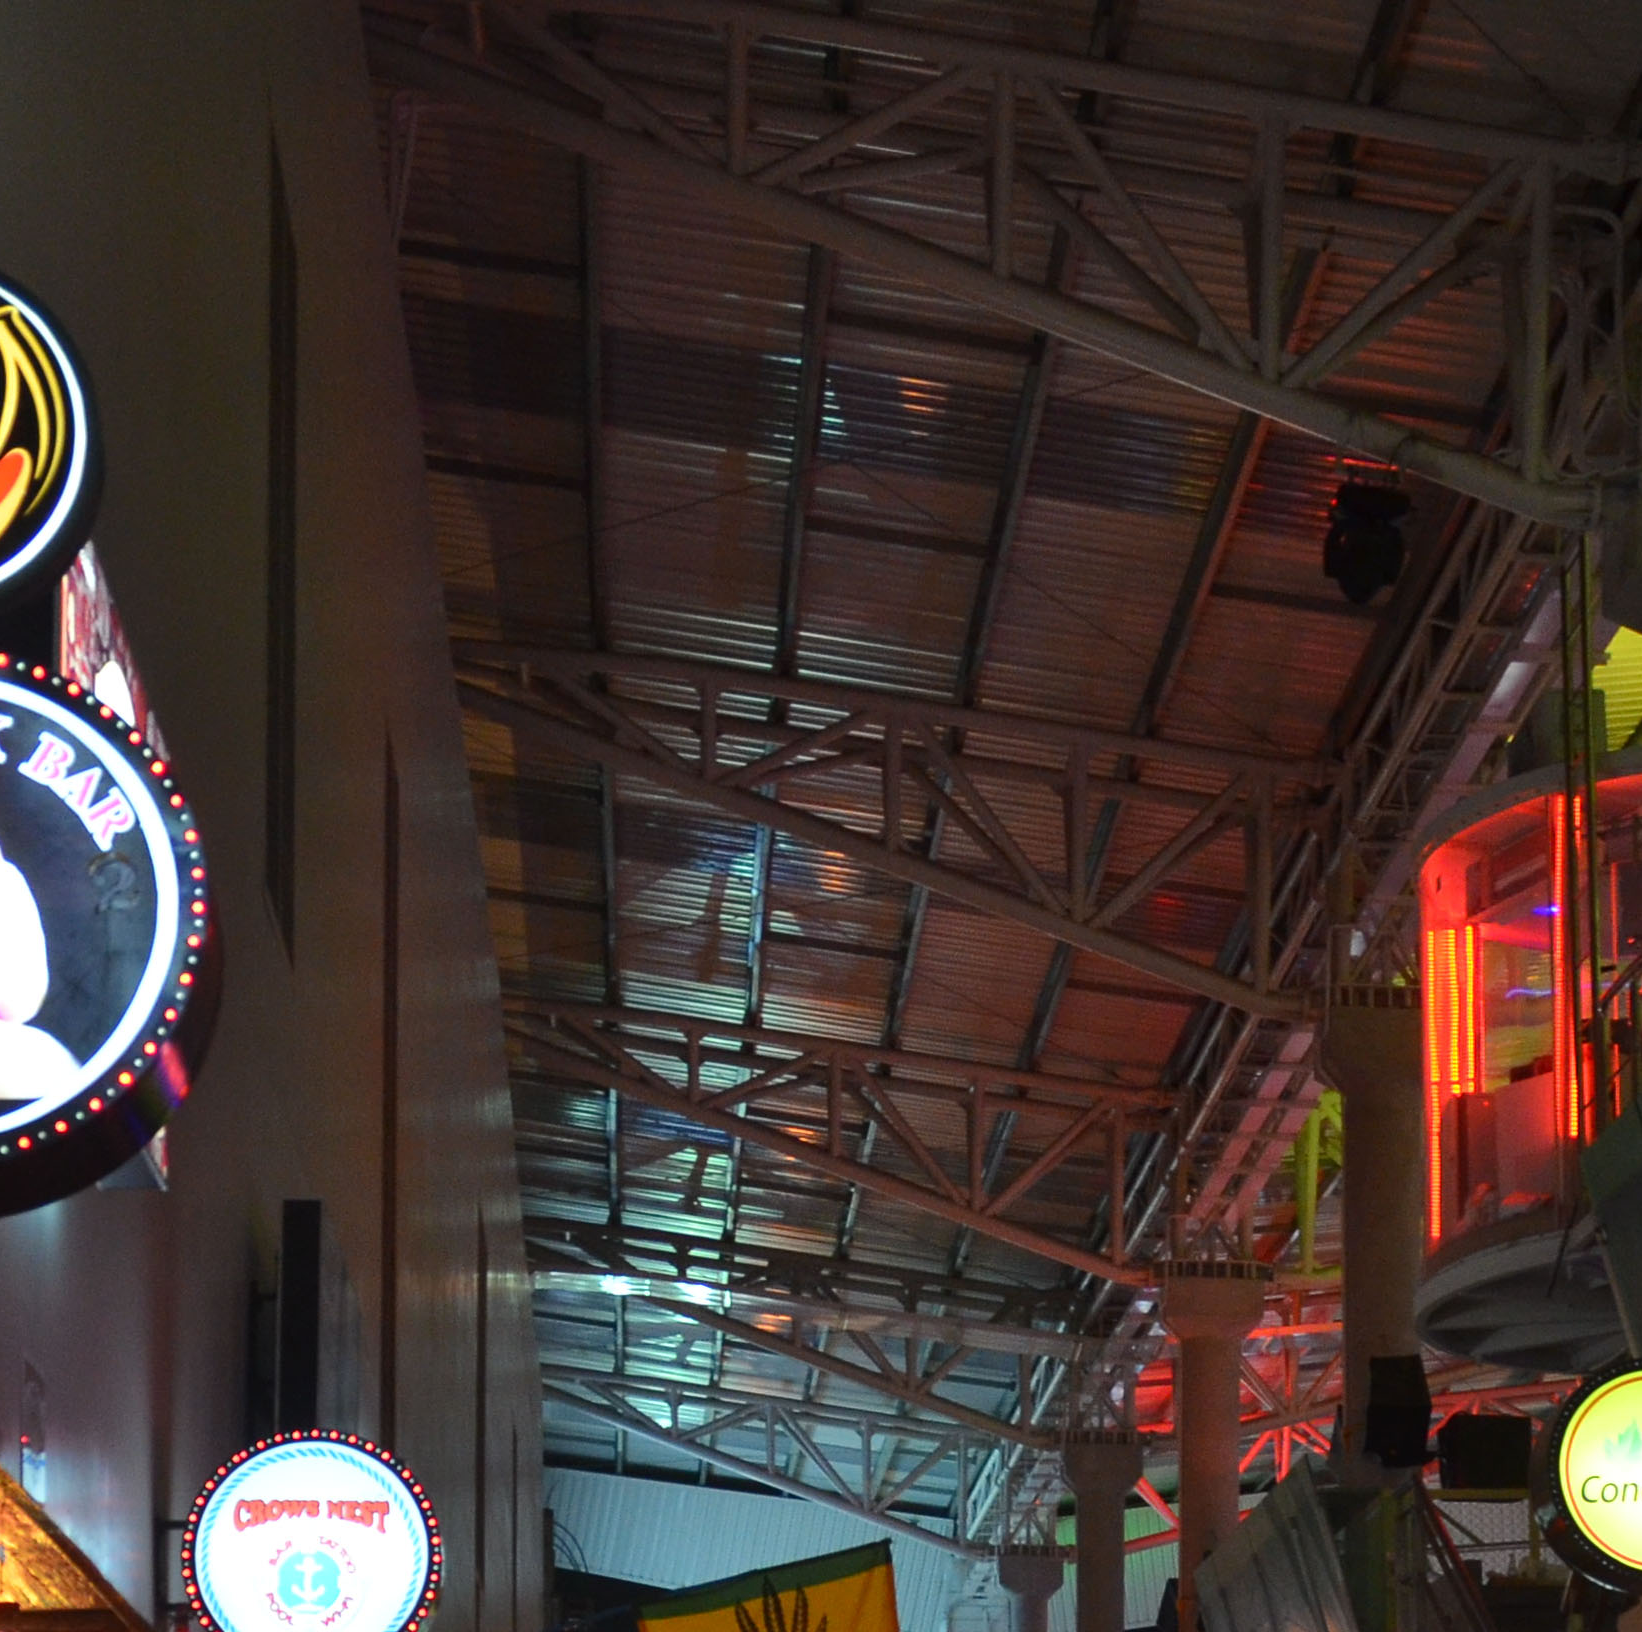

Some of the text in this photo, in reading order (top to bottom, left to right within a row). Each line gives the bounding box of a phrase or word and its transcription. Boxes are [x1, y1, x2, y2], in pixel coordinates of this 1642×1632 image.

[18, 729, 141, 855] BAR
[233, 1499, 391, 1535] CROWS NEST
